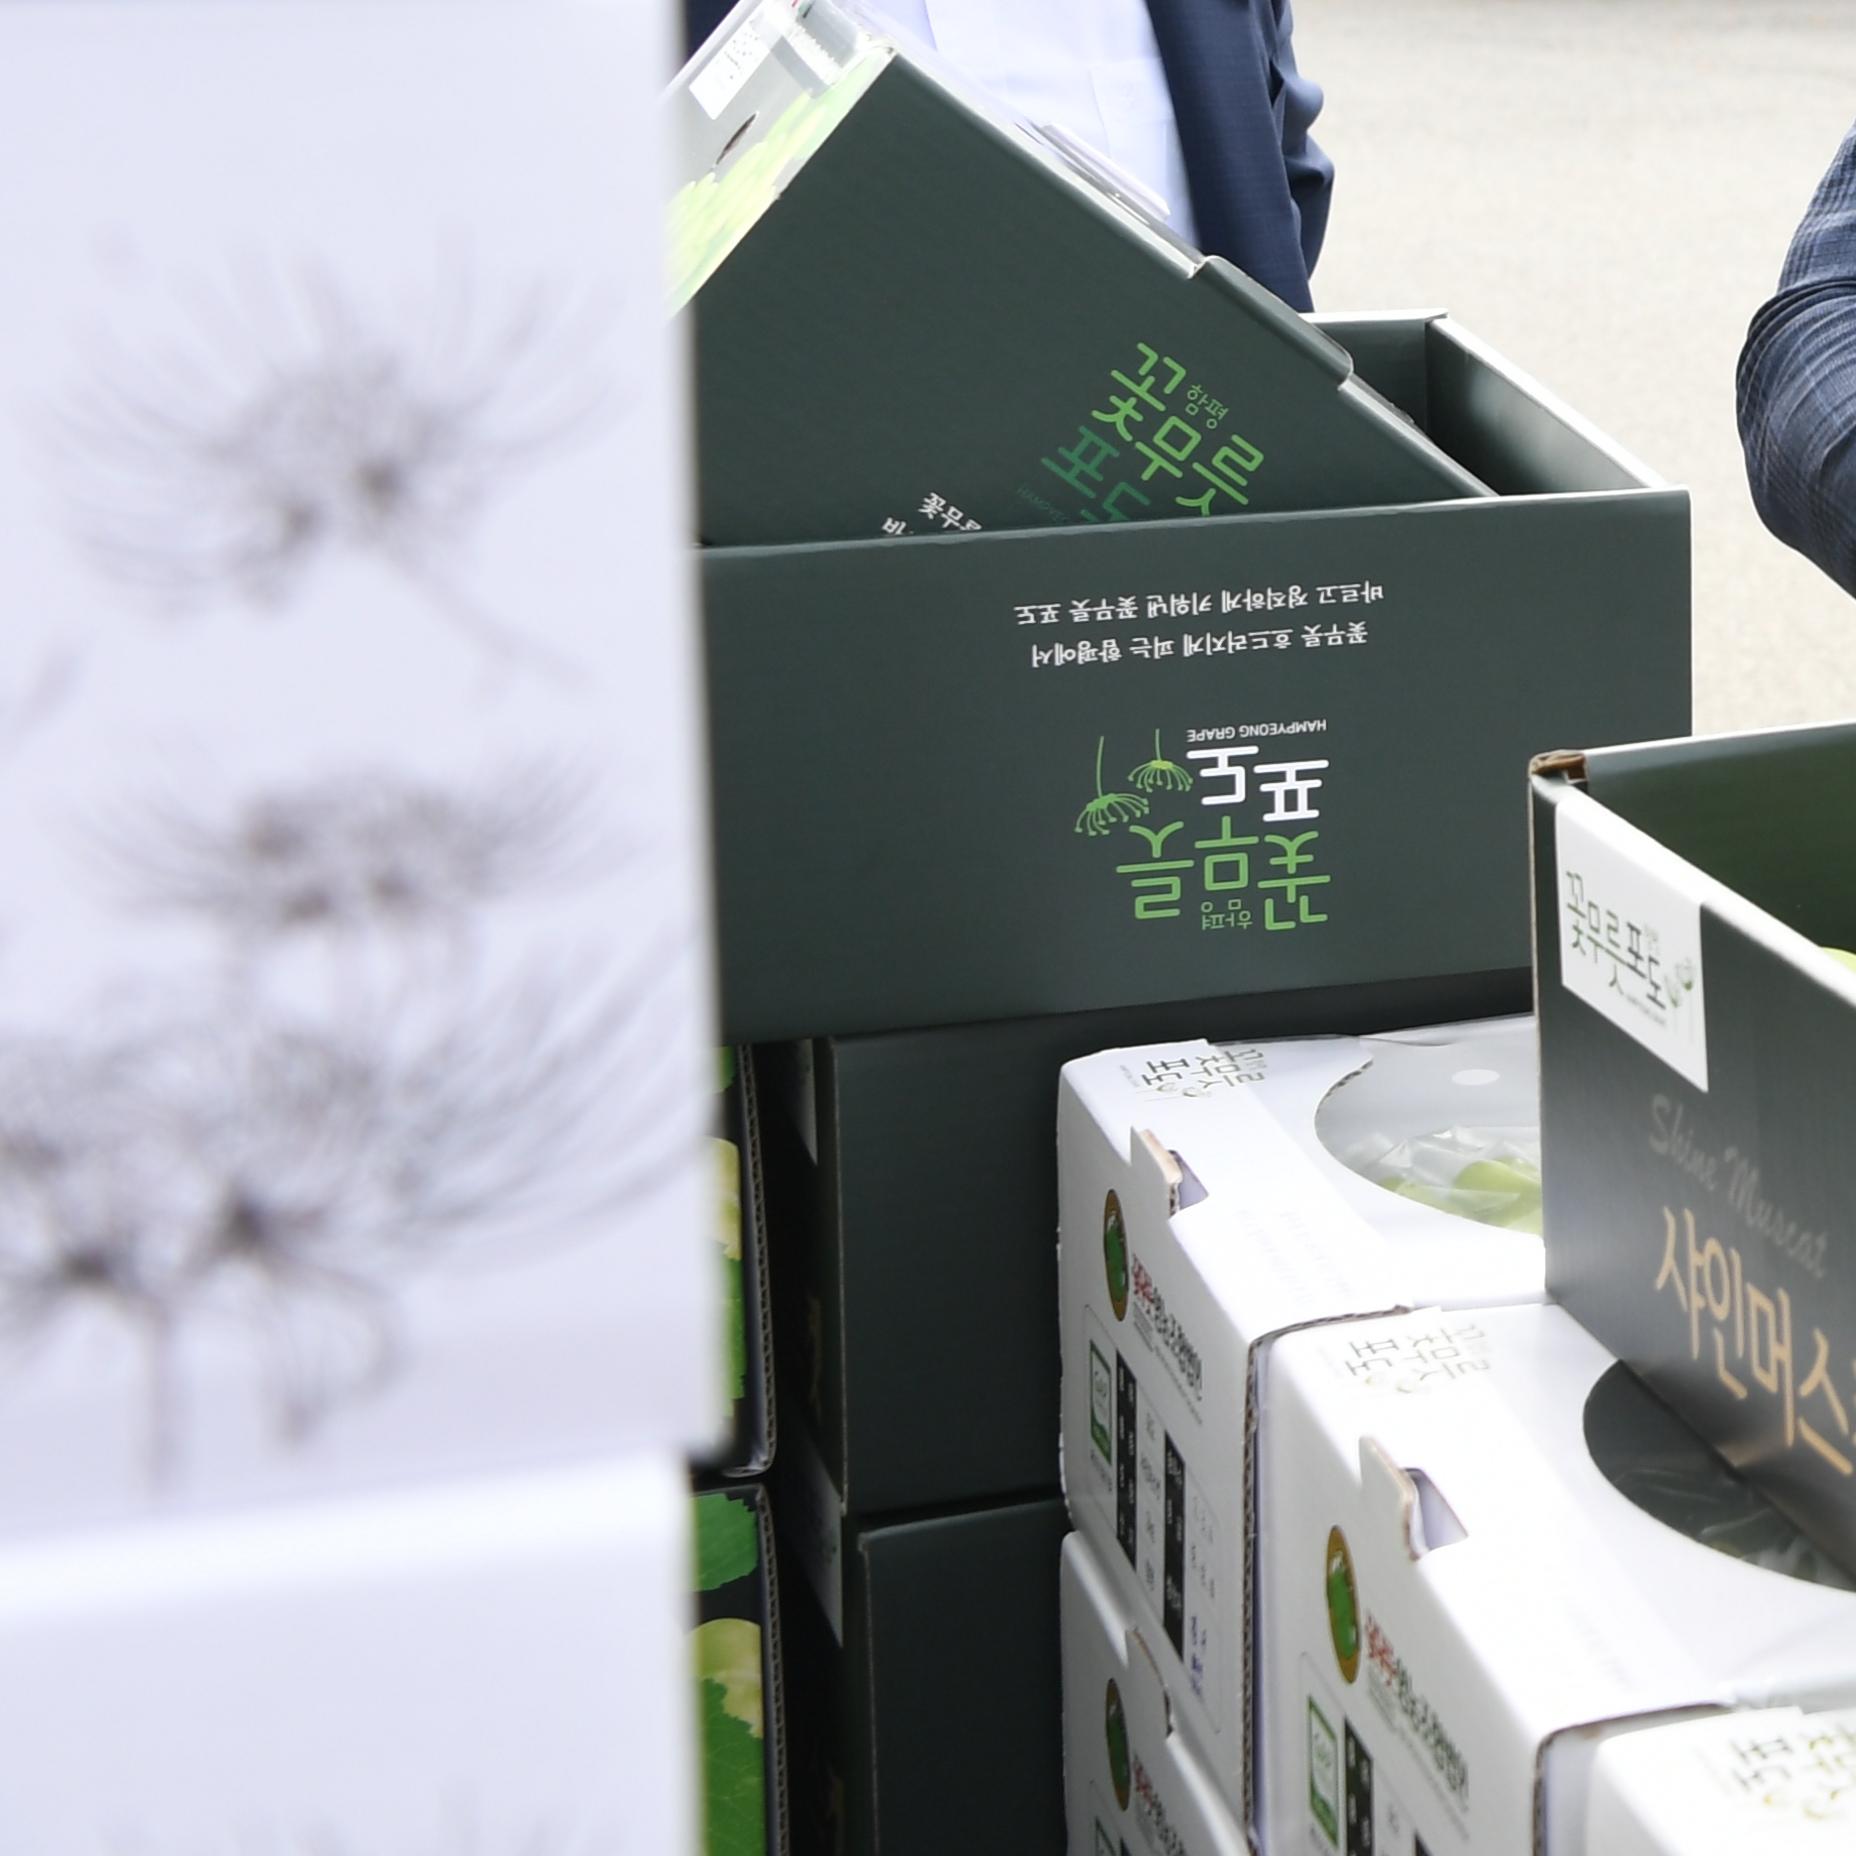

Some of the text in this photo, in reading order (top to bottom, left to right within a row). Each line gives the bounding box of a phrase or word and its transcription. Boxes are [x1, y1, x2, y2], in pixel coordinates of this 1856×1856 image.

[1091, 342, 1264, 515] 꽃무릇
[1186, 384, 1230, 429] 함평
[1014, 580, 1384, 625] 바르고 정직하게 키워낸 꽃무릇 포도
[1032, 621, 1368, 667] 꽃무릇 흐드러지게 피는 함평에서
[1186, 719, 1327, 742] HAMPYEONG GRAPE
[1186, 746, 1329, 822] 포도
[1116, 815, 1331, 930] 꽃무릇
[1201, 899, 1252, 930] 함평
[1648, 1094, 1829, 1279] Shine Muscat
